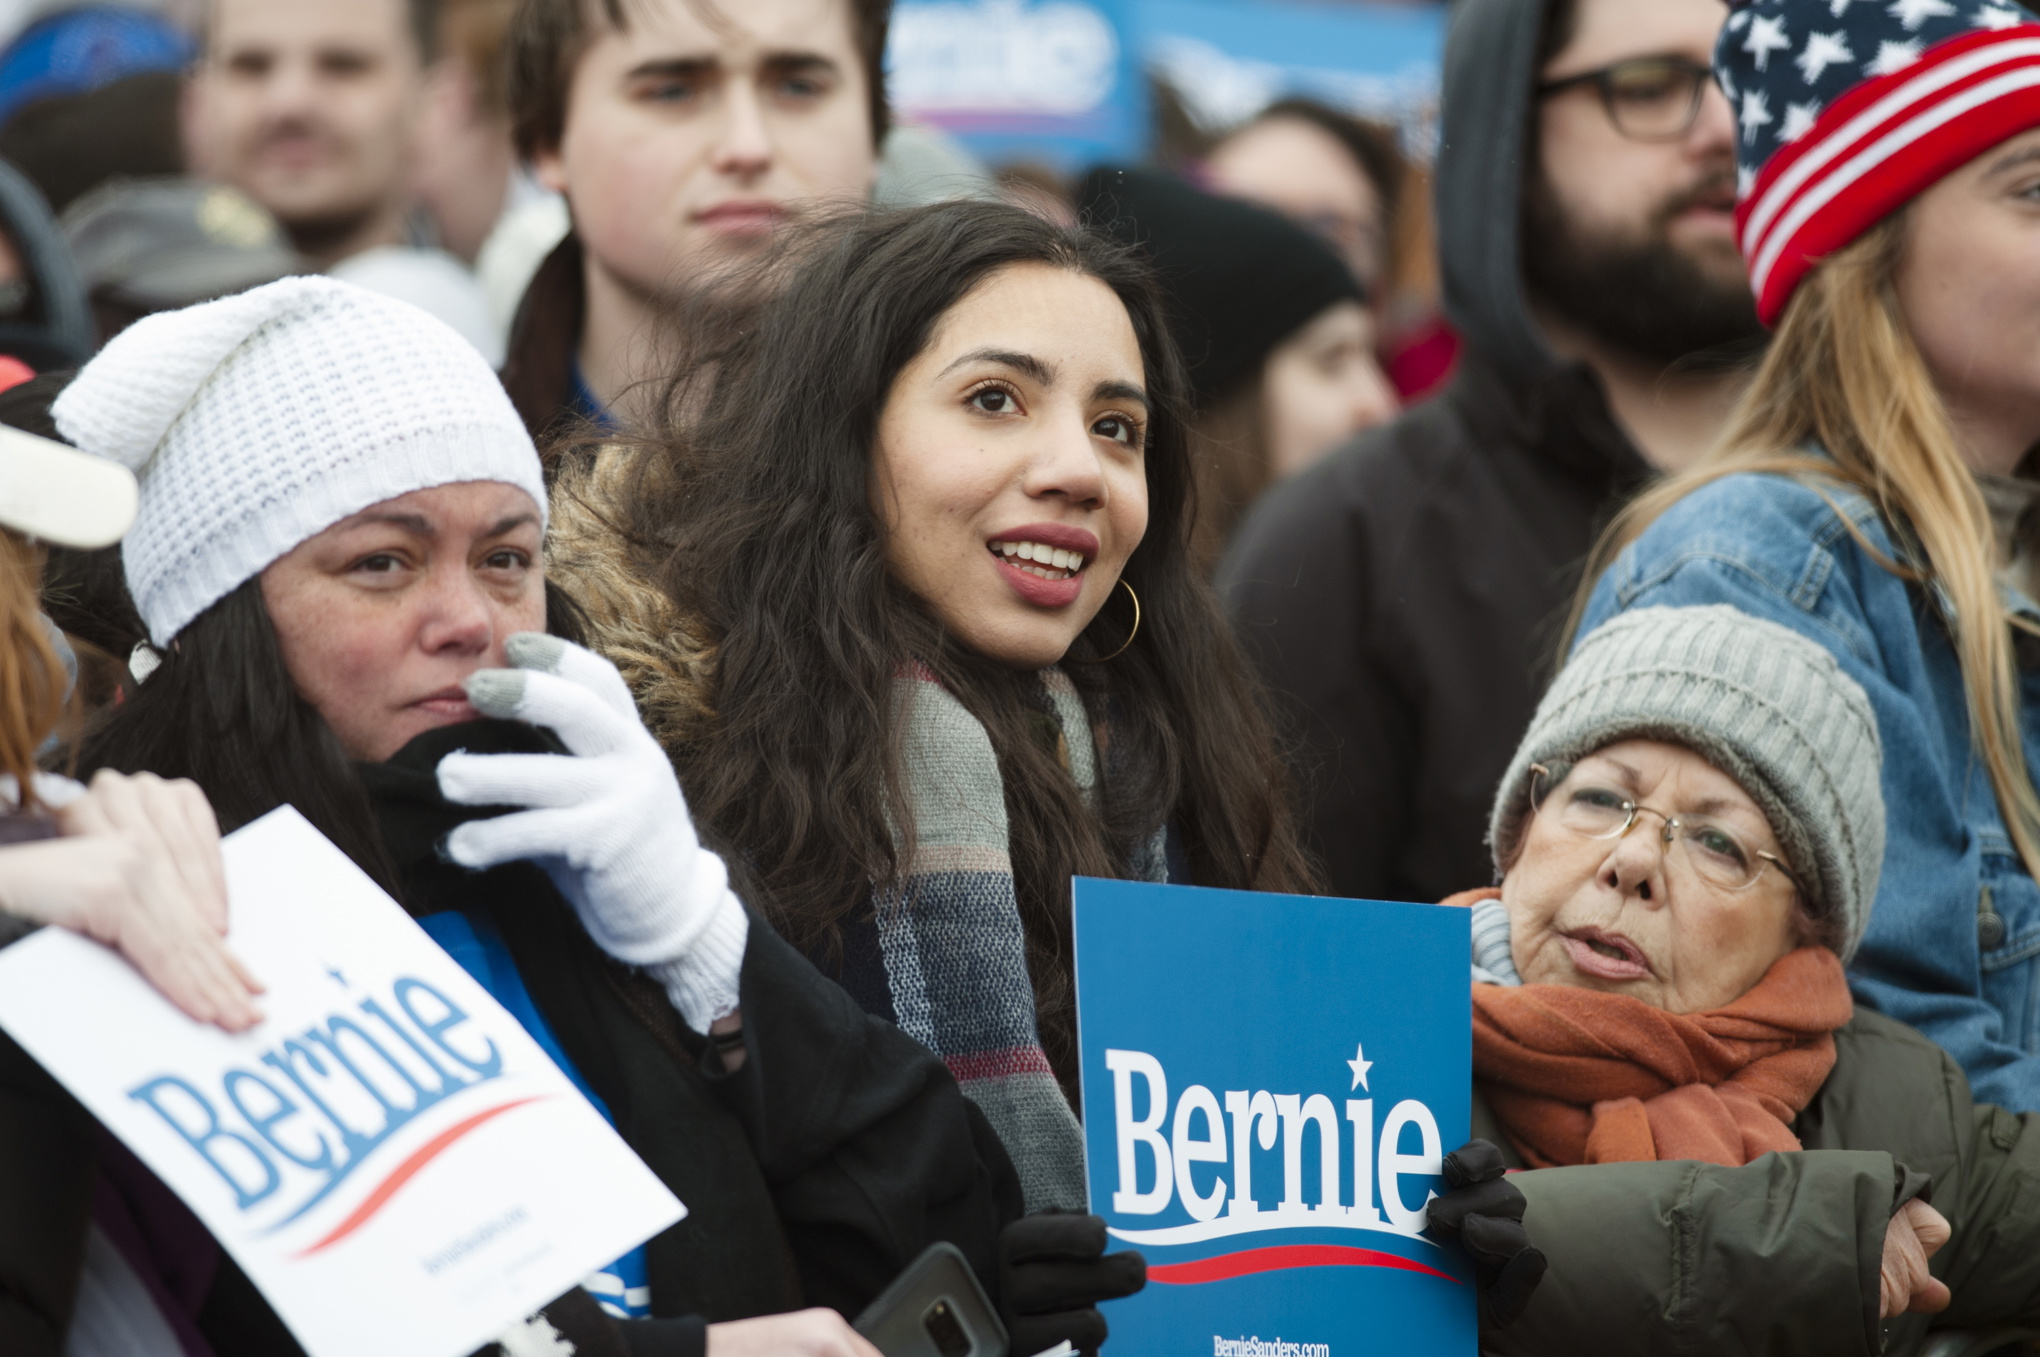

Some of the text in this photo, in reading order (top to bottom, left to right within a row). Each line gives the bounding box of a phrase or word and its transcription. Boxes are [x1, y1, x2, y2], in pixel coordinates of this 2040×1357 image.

[126, 962, 503, 1211] Bernie
[1105, 1043, 1443, 1233] Bernie
[1213, 1335, 1330, 1357] BernieSanders.com
